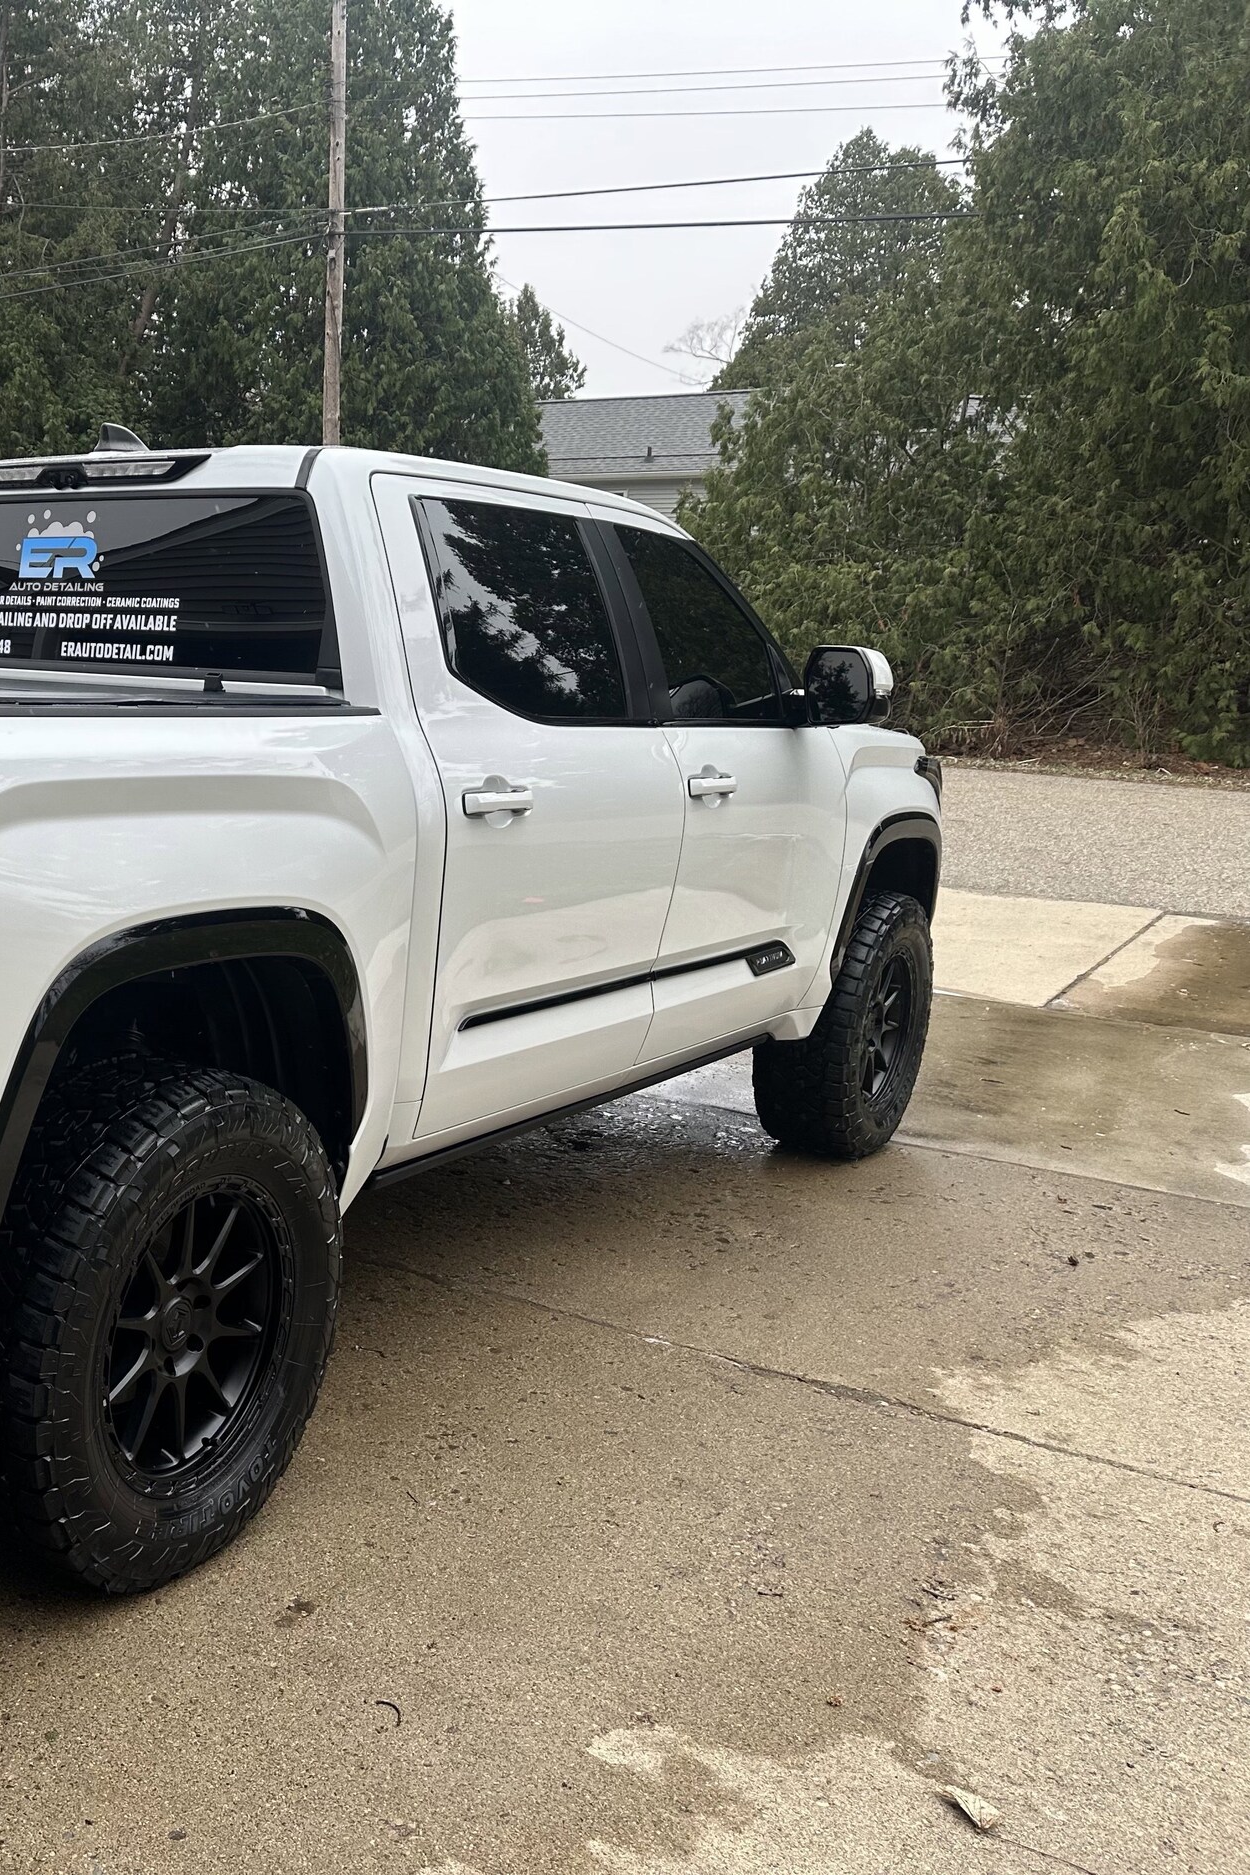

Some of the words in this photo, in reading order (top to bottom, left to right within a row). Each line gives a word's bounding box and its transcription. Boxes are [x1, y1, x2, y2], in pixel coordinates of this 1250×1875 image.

[18, 536, 98, 579] ER
[9, 582, 41, 591] AUTO
[43, 582, 104, 592] DETAILING
[5, 596, 32, 606] DETAILS
[36, 597, 55, 606] PAINT
[56, 597, 101, 607] CORRECTION
[106, 597, 140, 608] CERAMIC
[141, 598, 179, 608] COATINGS
[34, 613, 57, 628] AND
[59, 613, 90, 629] DROP
[92, 614, 113, 630] OFF
[114, 615, 177, 631] AVAILABLE
[61, 641, 174, 661] ERAUTODETAIL.COM
